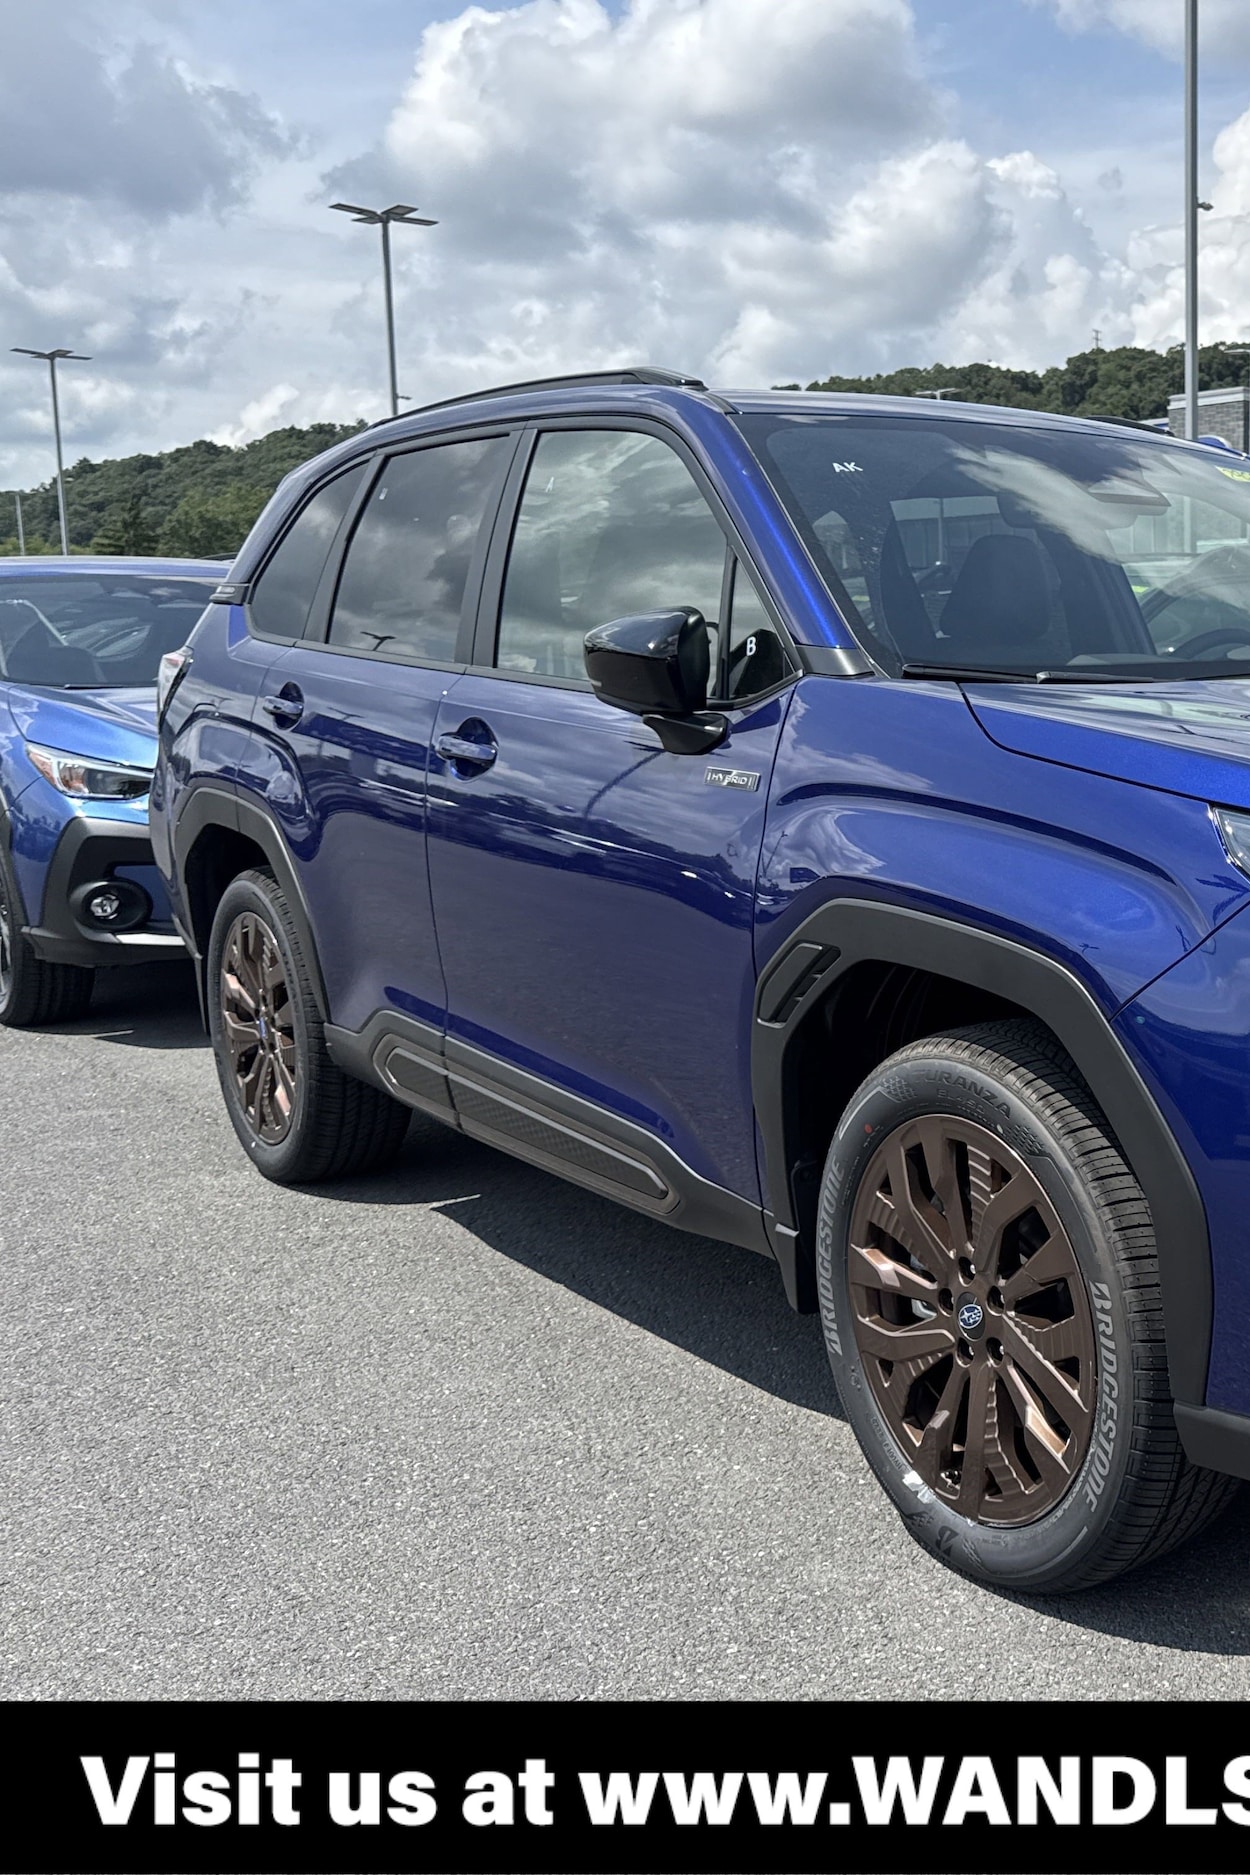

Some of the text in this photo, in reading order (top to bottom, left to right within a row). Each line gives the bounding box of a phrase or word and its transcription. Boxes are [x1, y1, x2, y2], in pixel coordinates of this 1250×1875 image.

[832, 462, 864, 473] AK
[746, 636, 757, 656] B
[818, 1154, 845, 1357] BRIDGESTONE
[1082, 1280, 1118, 1513] BRIDGESTONE
